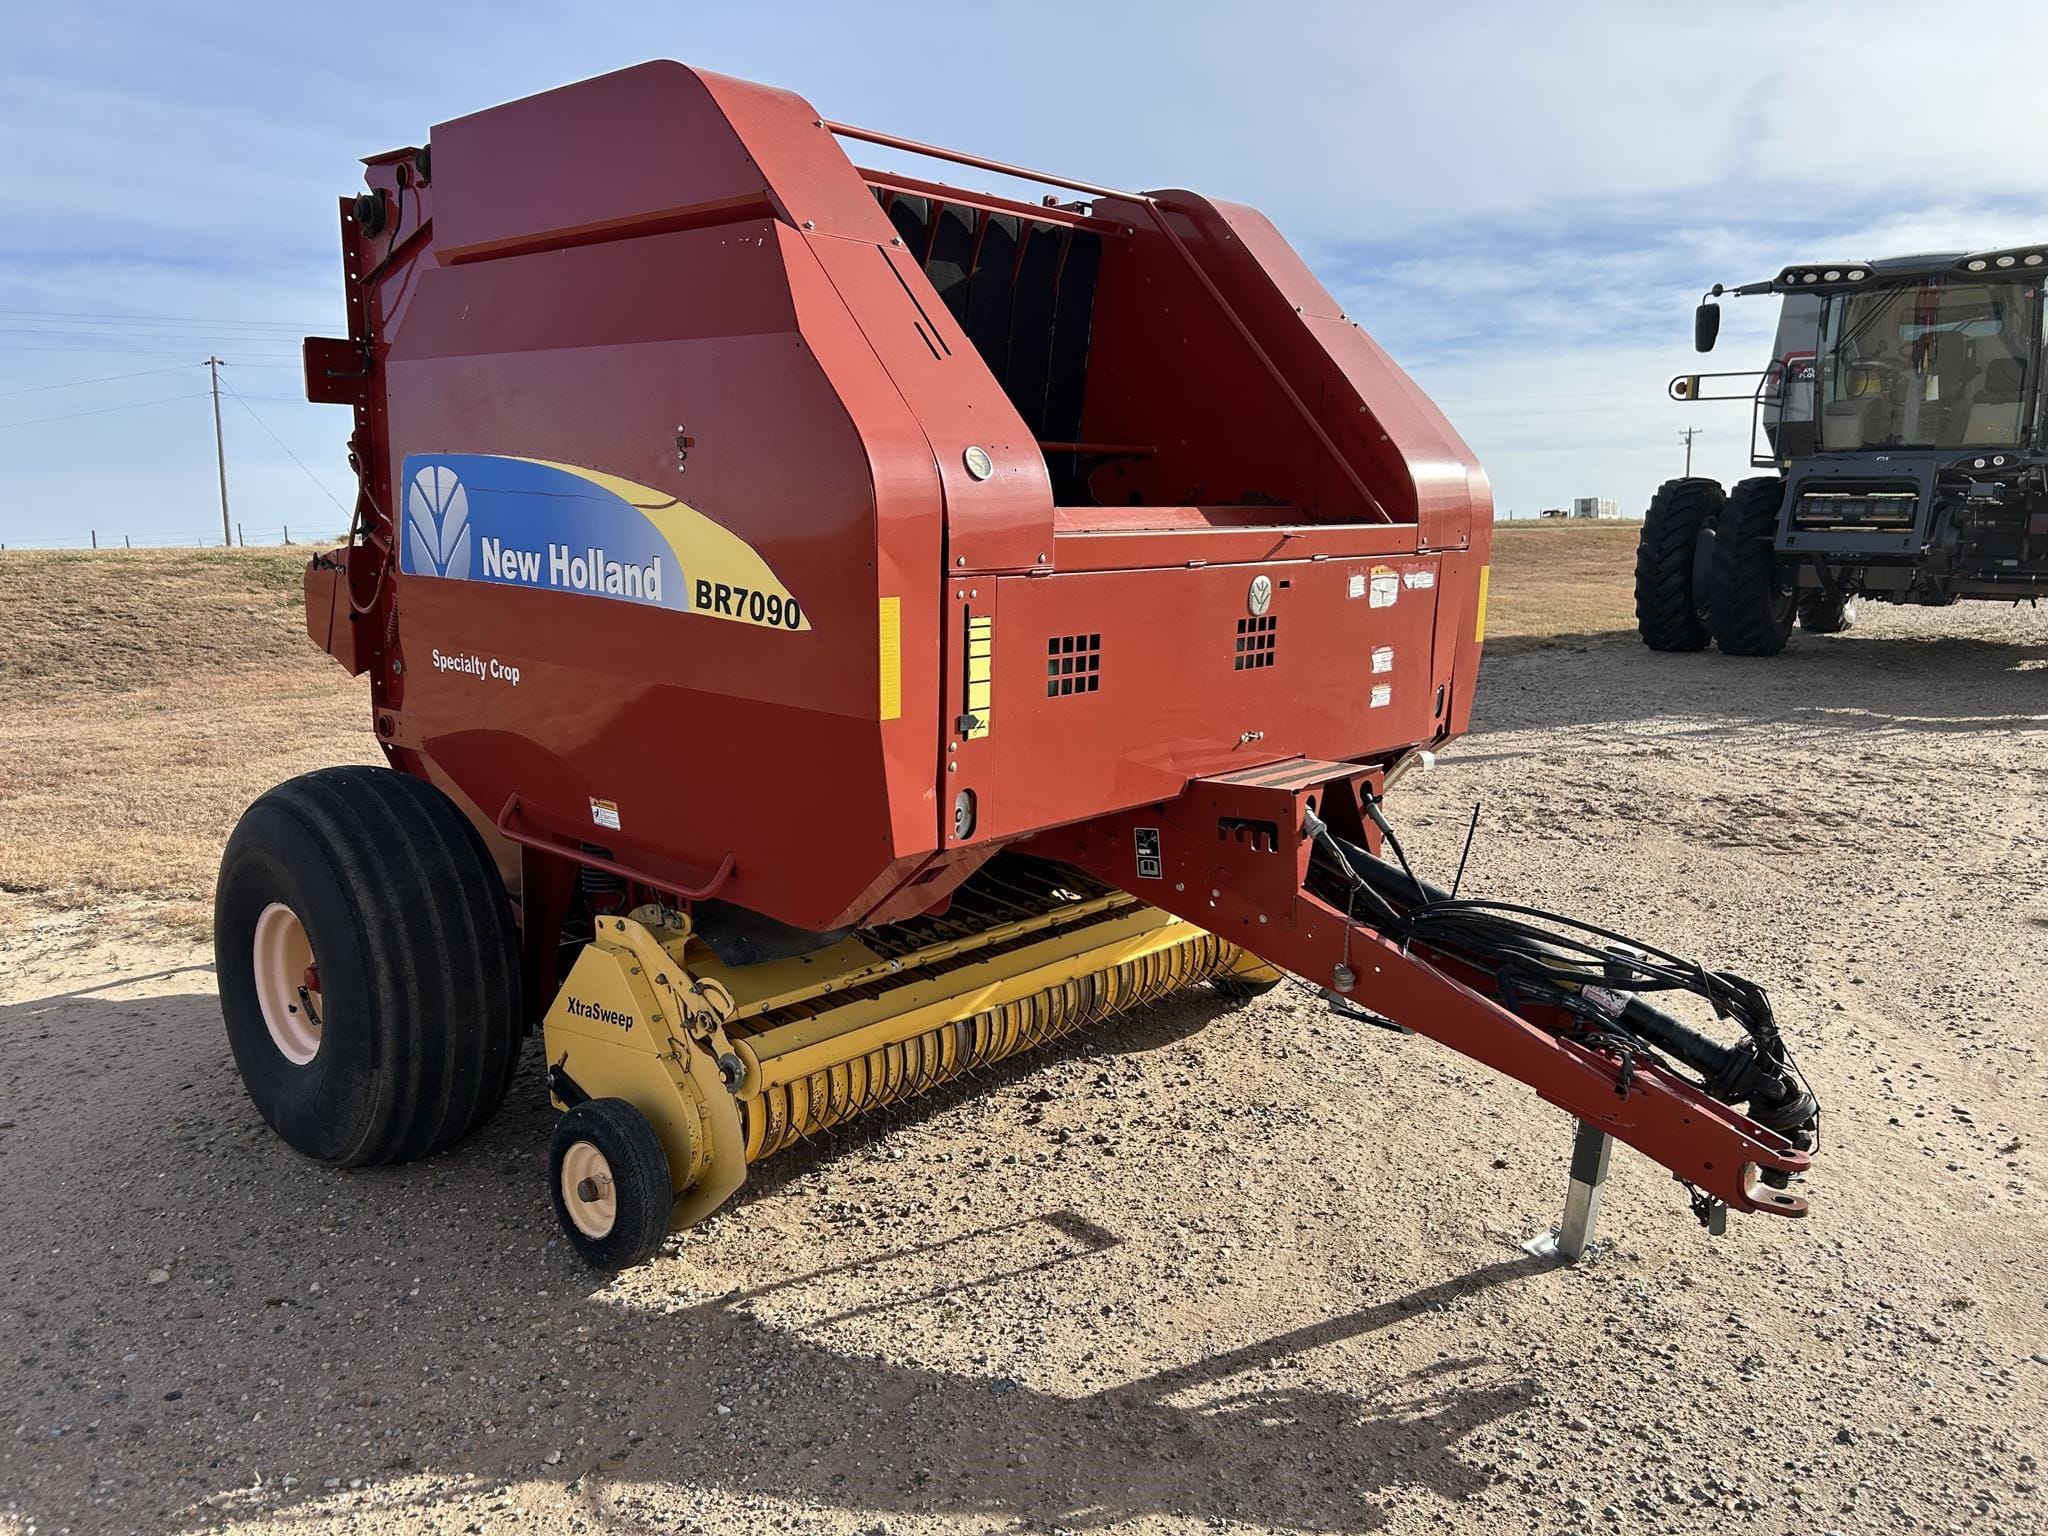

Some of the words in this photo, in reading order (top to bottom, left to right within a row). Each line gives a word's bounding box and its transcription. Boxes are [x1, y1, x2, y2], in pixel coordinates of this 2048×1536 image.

[481, 537, 541, 584] New
[549, 543, 663, 602] Holland
[696, 579, 801, 630] BR7090
[432, 648, 487, 681] Specialty
[490, 658, 521, 687] Crop
[567, 996, 634, 1032] XtraSweep
